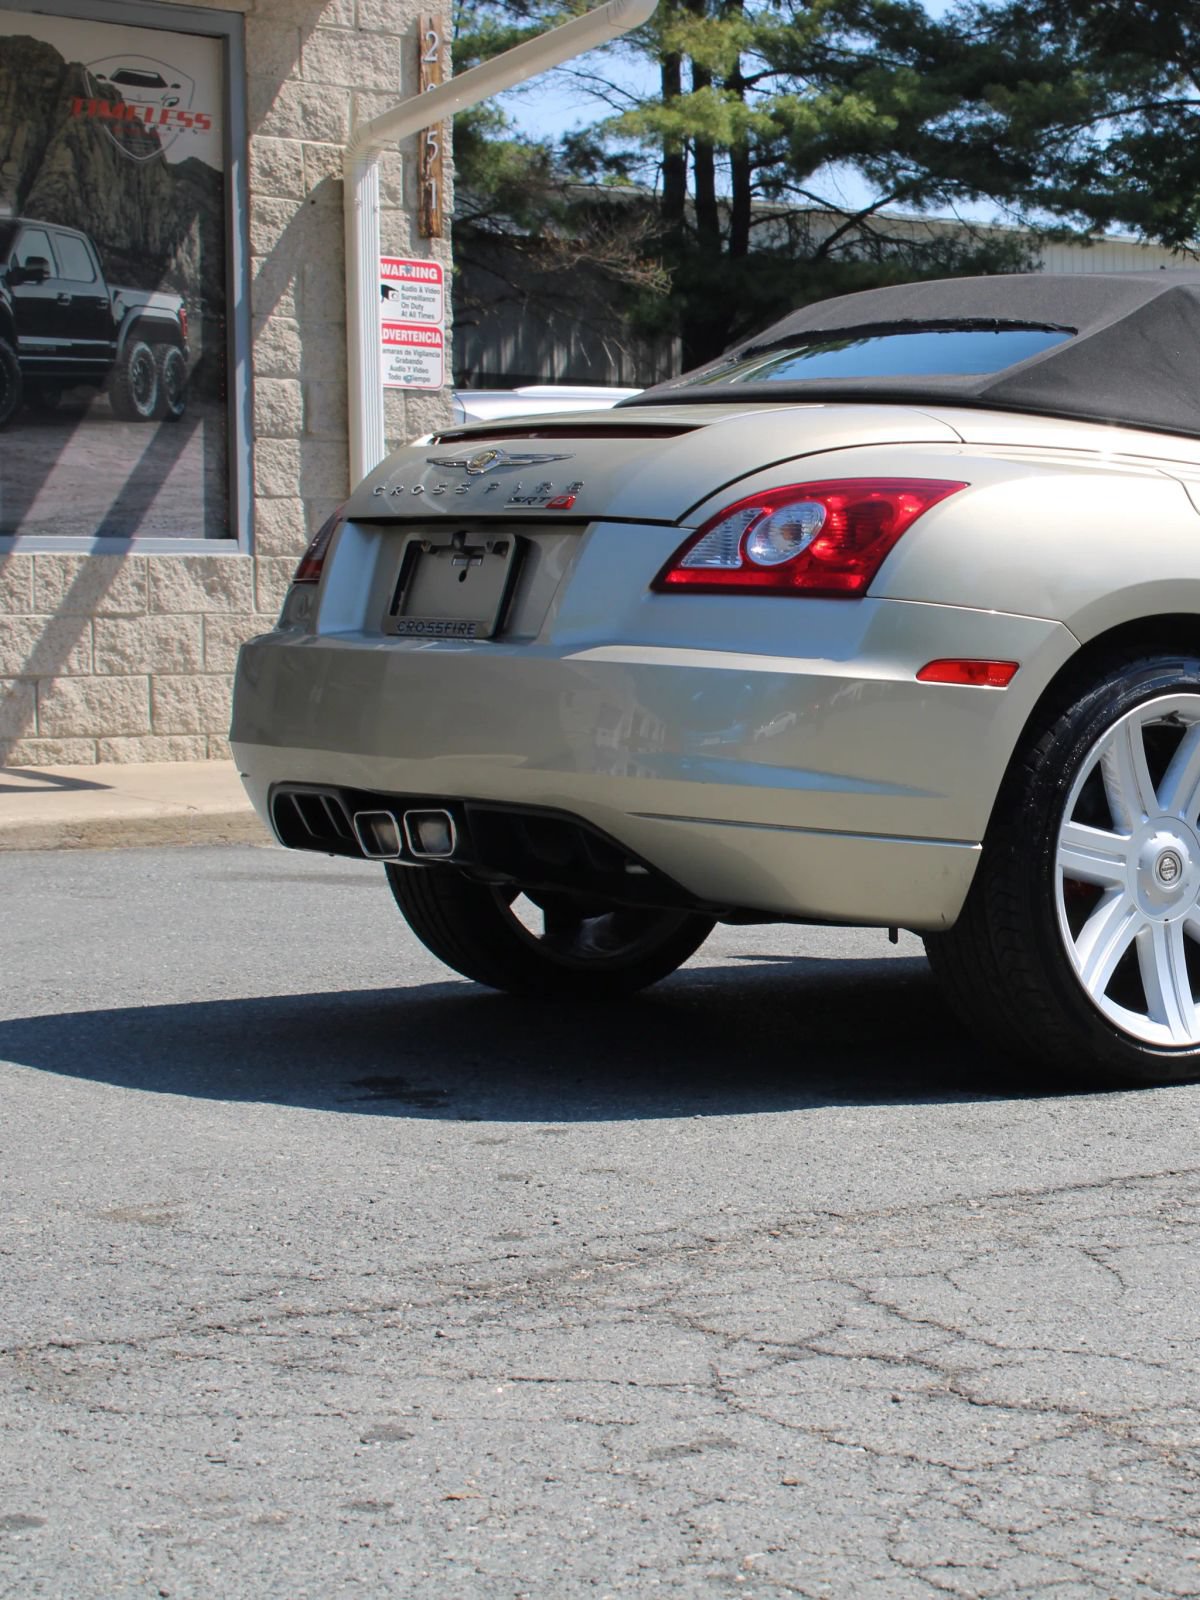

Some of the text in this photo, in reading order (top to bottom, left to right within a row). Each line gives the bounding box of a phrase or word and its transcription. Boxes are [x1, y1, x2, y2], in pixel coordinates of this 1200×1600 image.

[70, 95, 212, 132] TIMELESS
[422, 31, 439, 209] 251
[401, 284, 417, 293] Audio
[425, 286, 441, 295] Video
[401, 293, 436, 303] Surveillance
[401, 301, 424, 312] On Duty
[401, 310, 435, 320] At All Times
[382, 328, 442, 345] DVERTENCIA
[413, 349, 441, 359] Vigilancia
[395, 356, 424, 366] Grabando
[390, 364, 406, 373] Audio
[412, 366, 429, 375] Video
[388, 372, 402, 381] Todo
[372, 480, 585, 497] CROSSFIRE
[396, 620, 477, 635] CROSSFIRE
